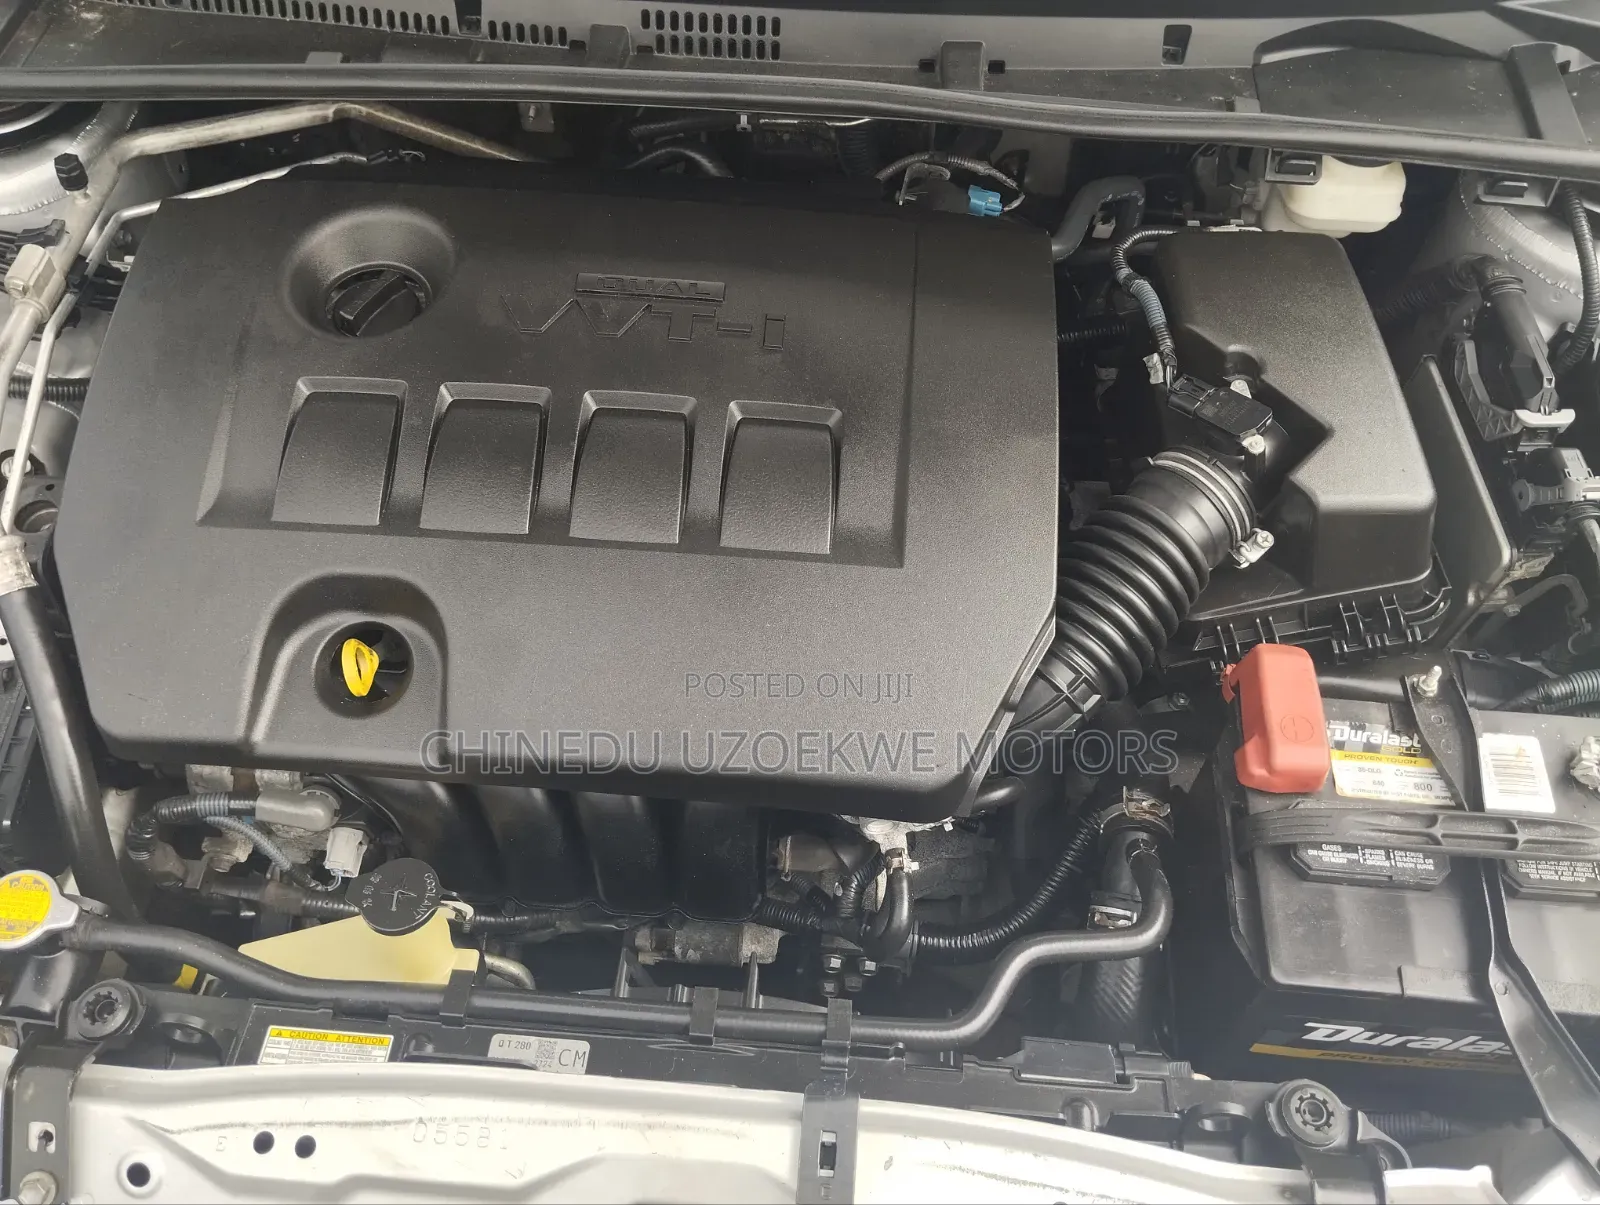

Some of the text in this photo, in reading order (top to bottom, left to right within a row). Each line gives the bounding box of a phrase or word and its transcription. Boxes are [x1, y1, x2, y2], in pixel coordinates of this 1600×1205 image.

[597, 276, 711, 295] DUAL
[1327, 724, 1422, 748] Duralast
[1381, 745, 1421, 754] GOLD
[1344, 753, 1382, 762] PROVEN
[1413, 781, 1433, 792] 800
[1322, 844, 1342, 852] GASES
[411, 872, 436, 920] COOLANT
[289, 1031, 385, 1045] CAUTION ATTENTION
[559, 1049, 587, 1068] CM
